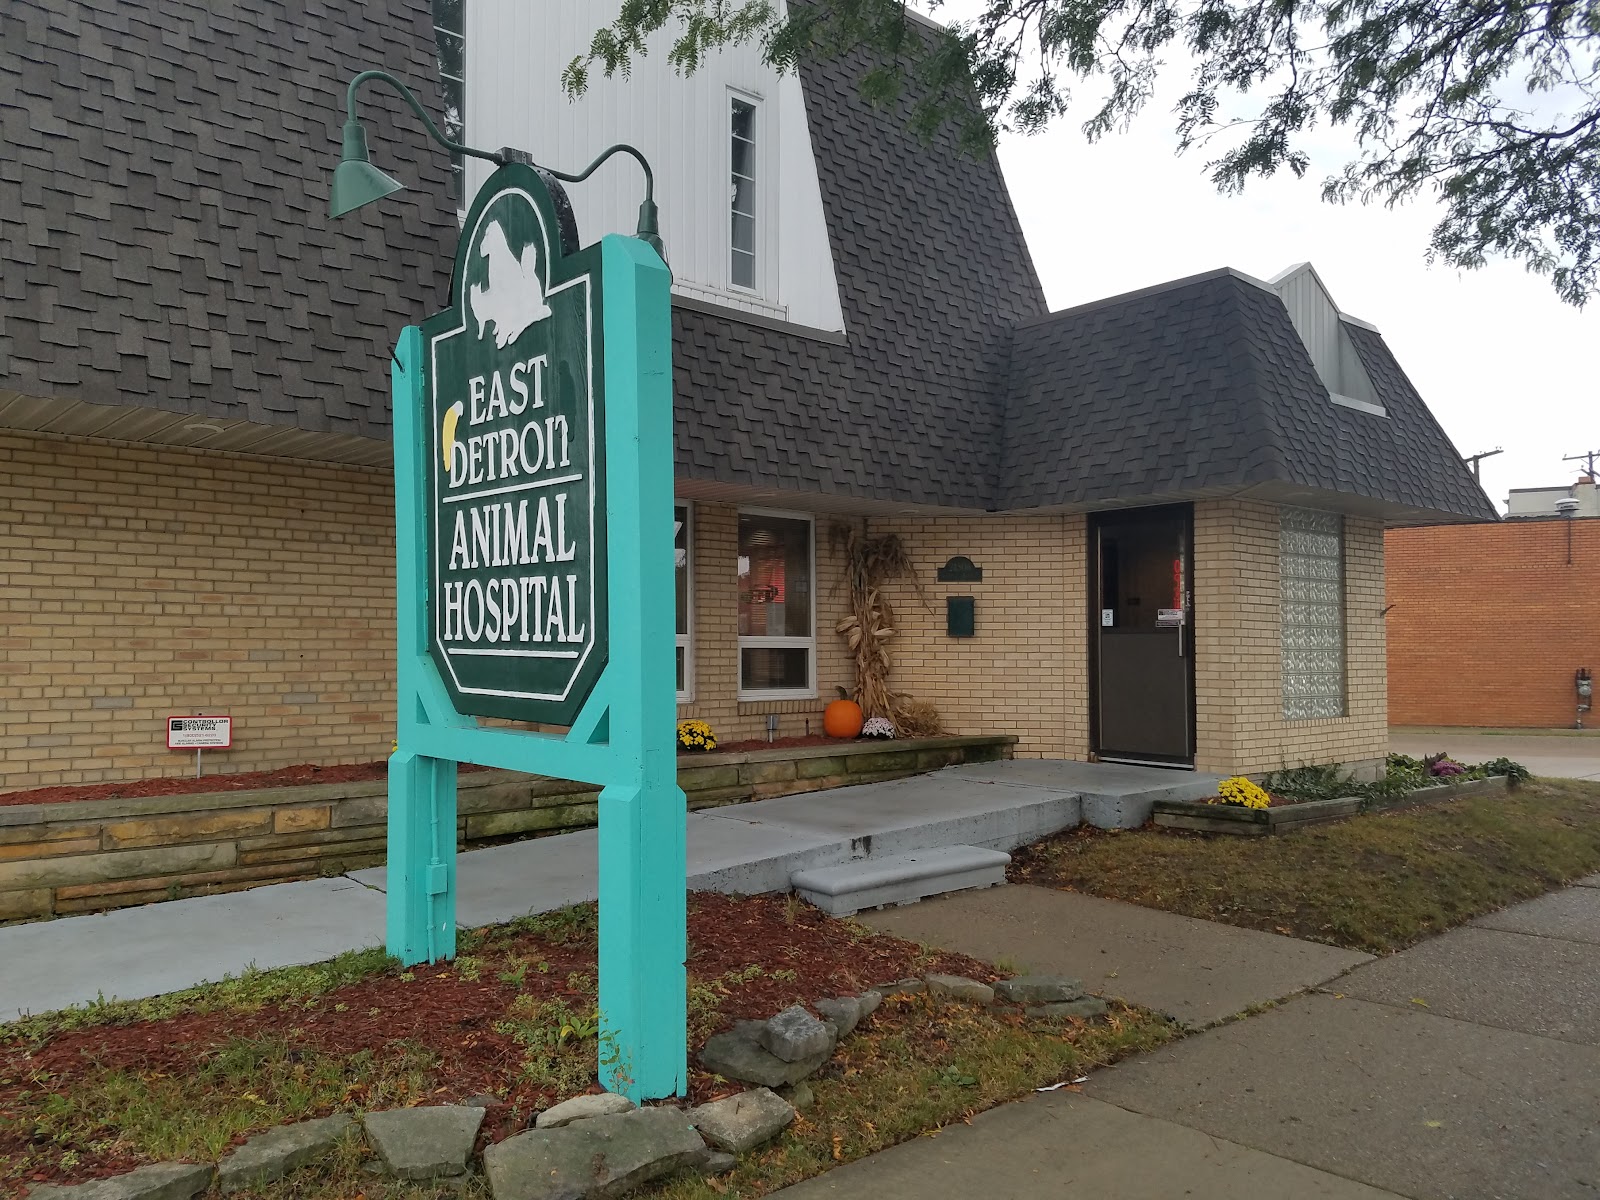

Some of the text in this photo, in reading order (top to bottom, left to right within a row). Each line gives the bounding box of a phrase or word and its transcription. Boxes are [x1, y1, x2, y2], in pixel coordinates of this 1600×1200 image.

[469, 354, 548, 425] EAST
[449, 493, 576, 570] ANIMAL
[443, 574, 585, 643] HOSPITAL
